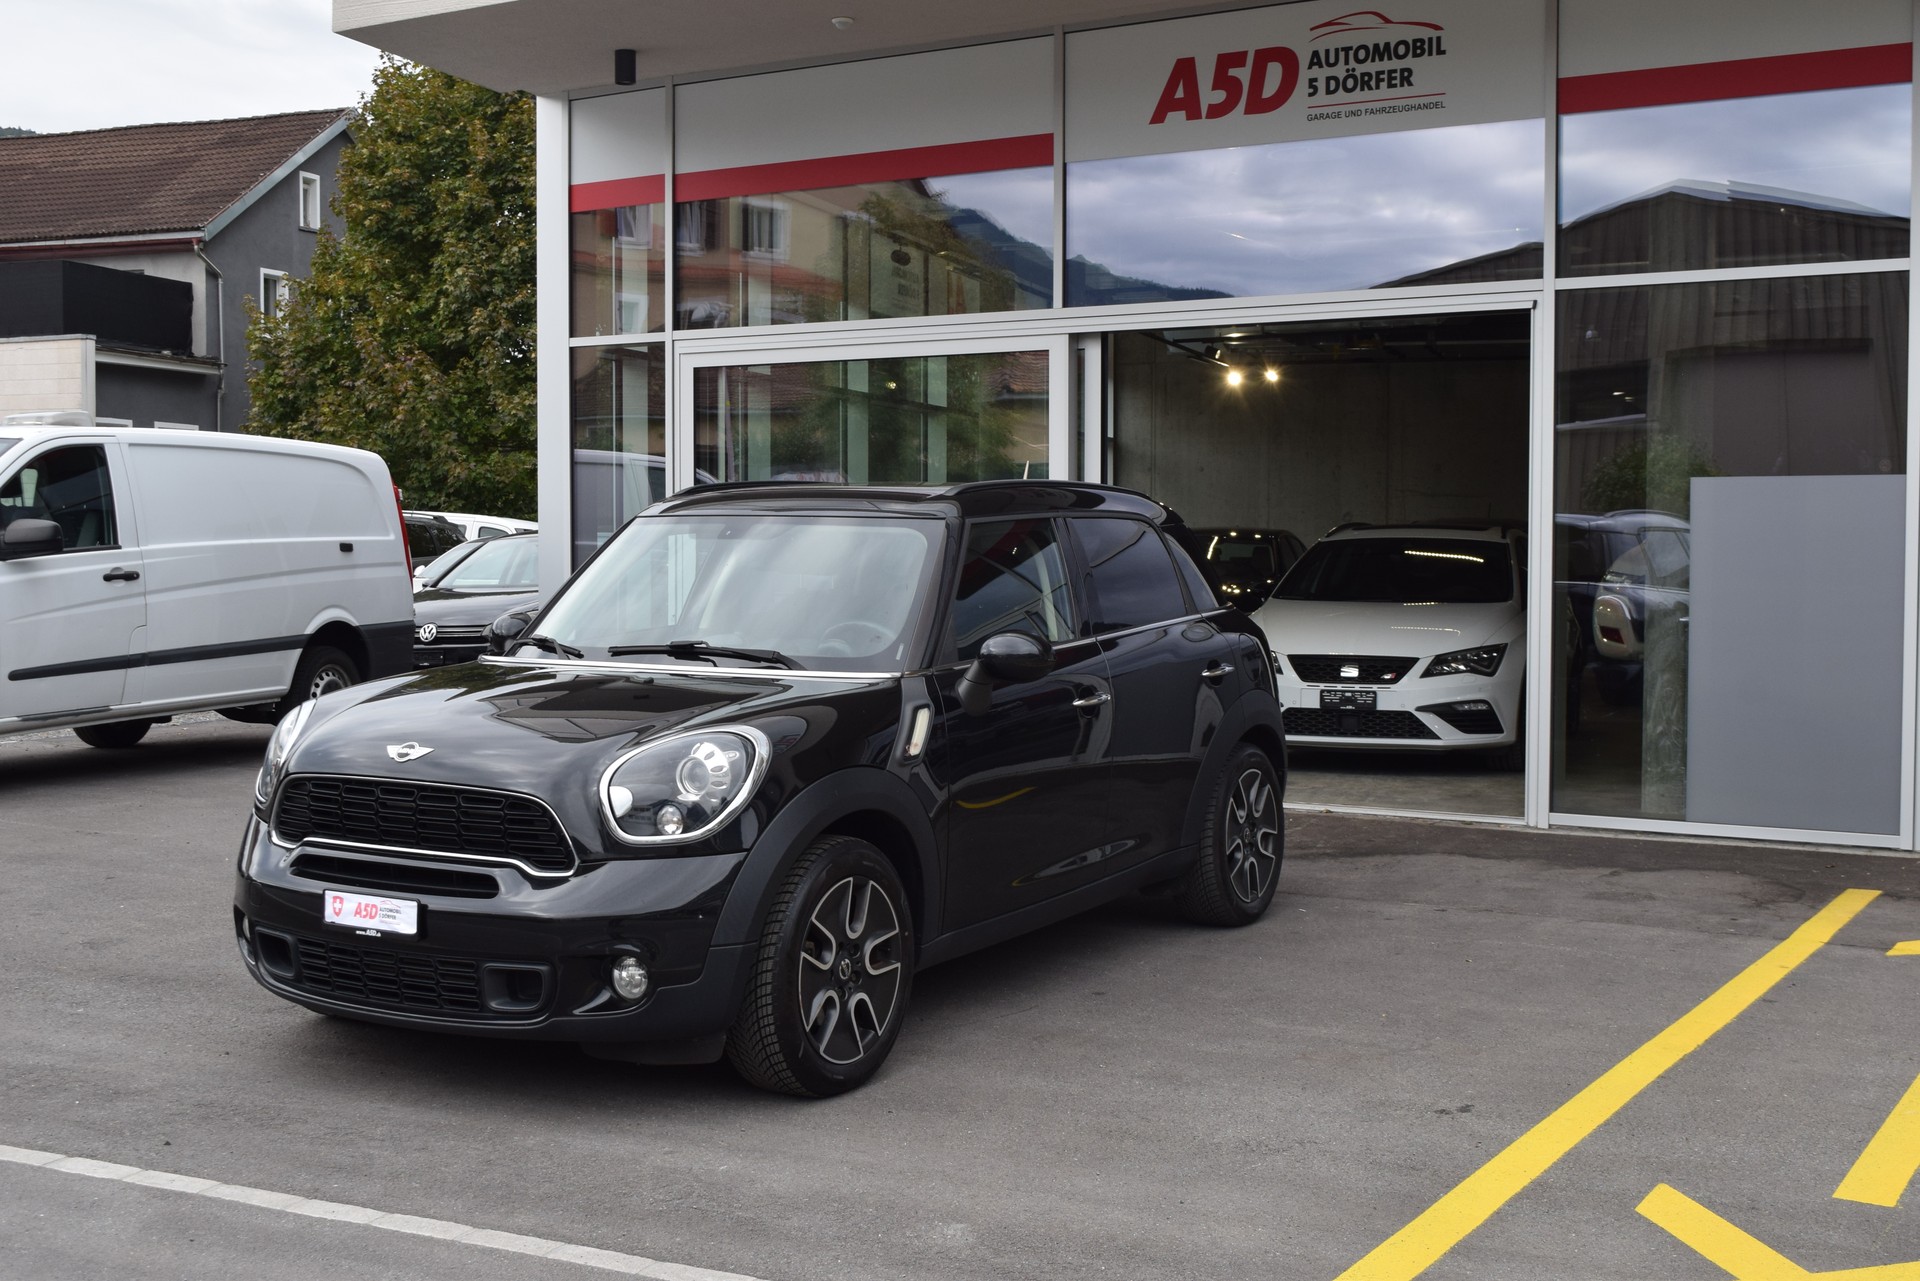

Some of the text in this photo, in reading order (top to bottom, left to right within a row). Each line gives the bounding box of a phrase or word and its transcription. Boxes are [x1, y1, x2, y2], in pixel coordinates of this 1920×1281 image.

[1307, 36, 1447, 70] AUTOMOBIL
[1149, 46, 1300, 125] A5D
[1307, 67, 1414, 98] 5 DÖRFER
[1306, 101, 1446, 122] GARAGE UND FAHRZEUGHANDEL
[354, 902, 378, 920] A5D
